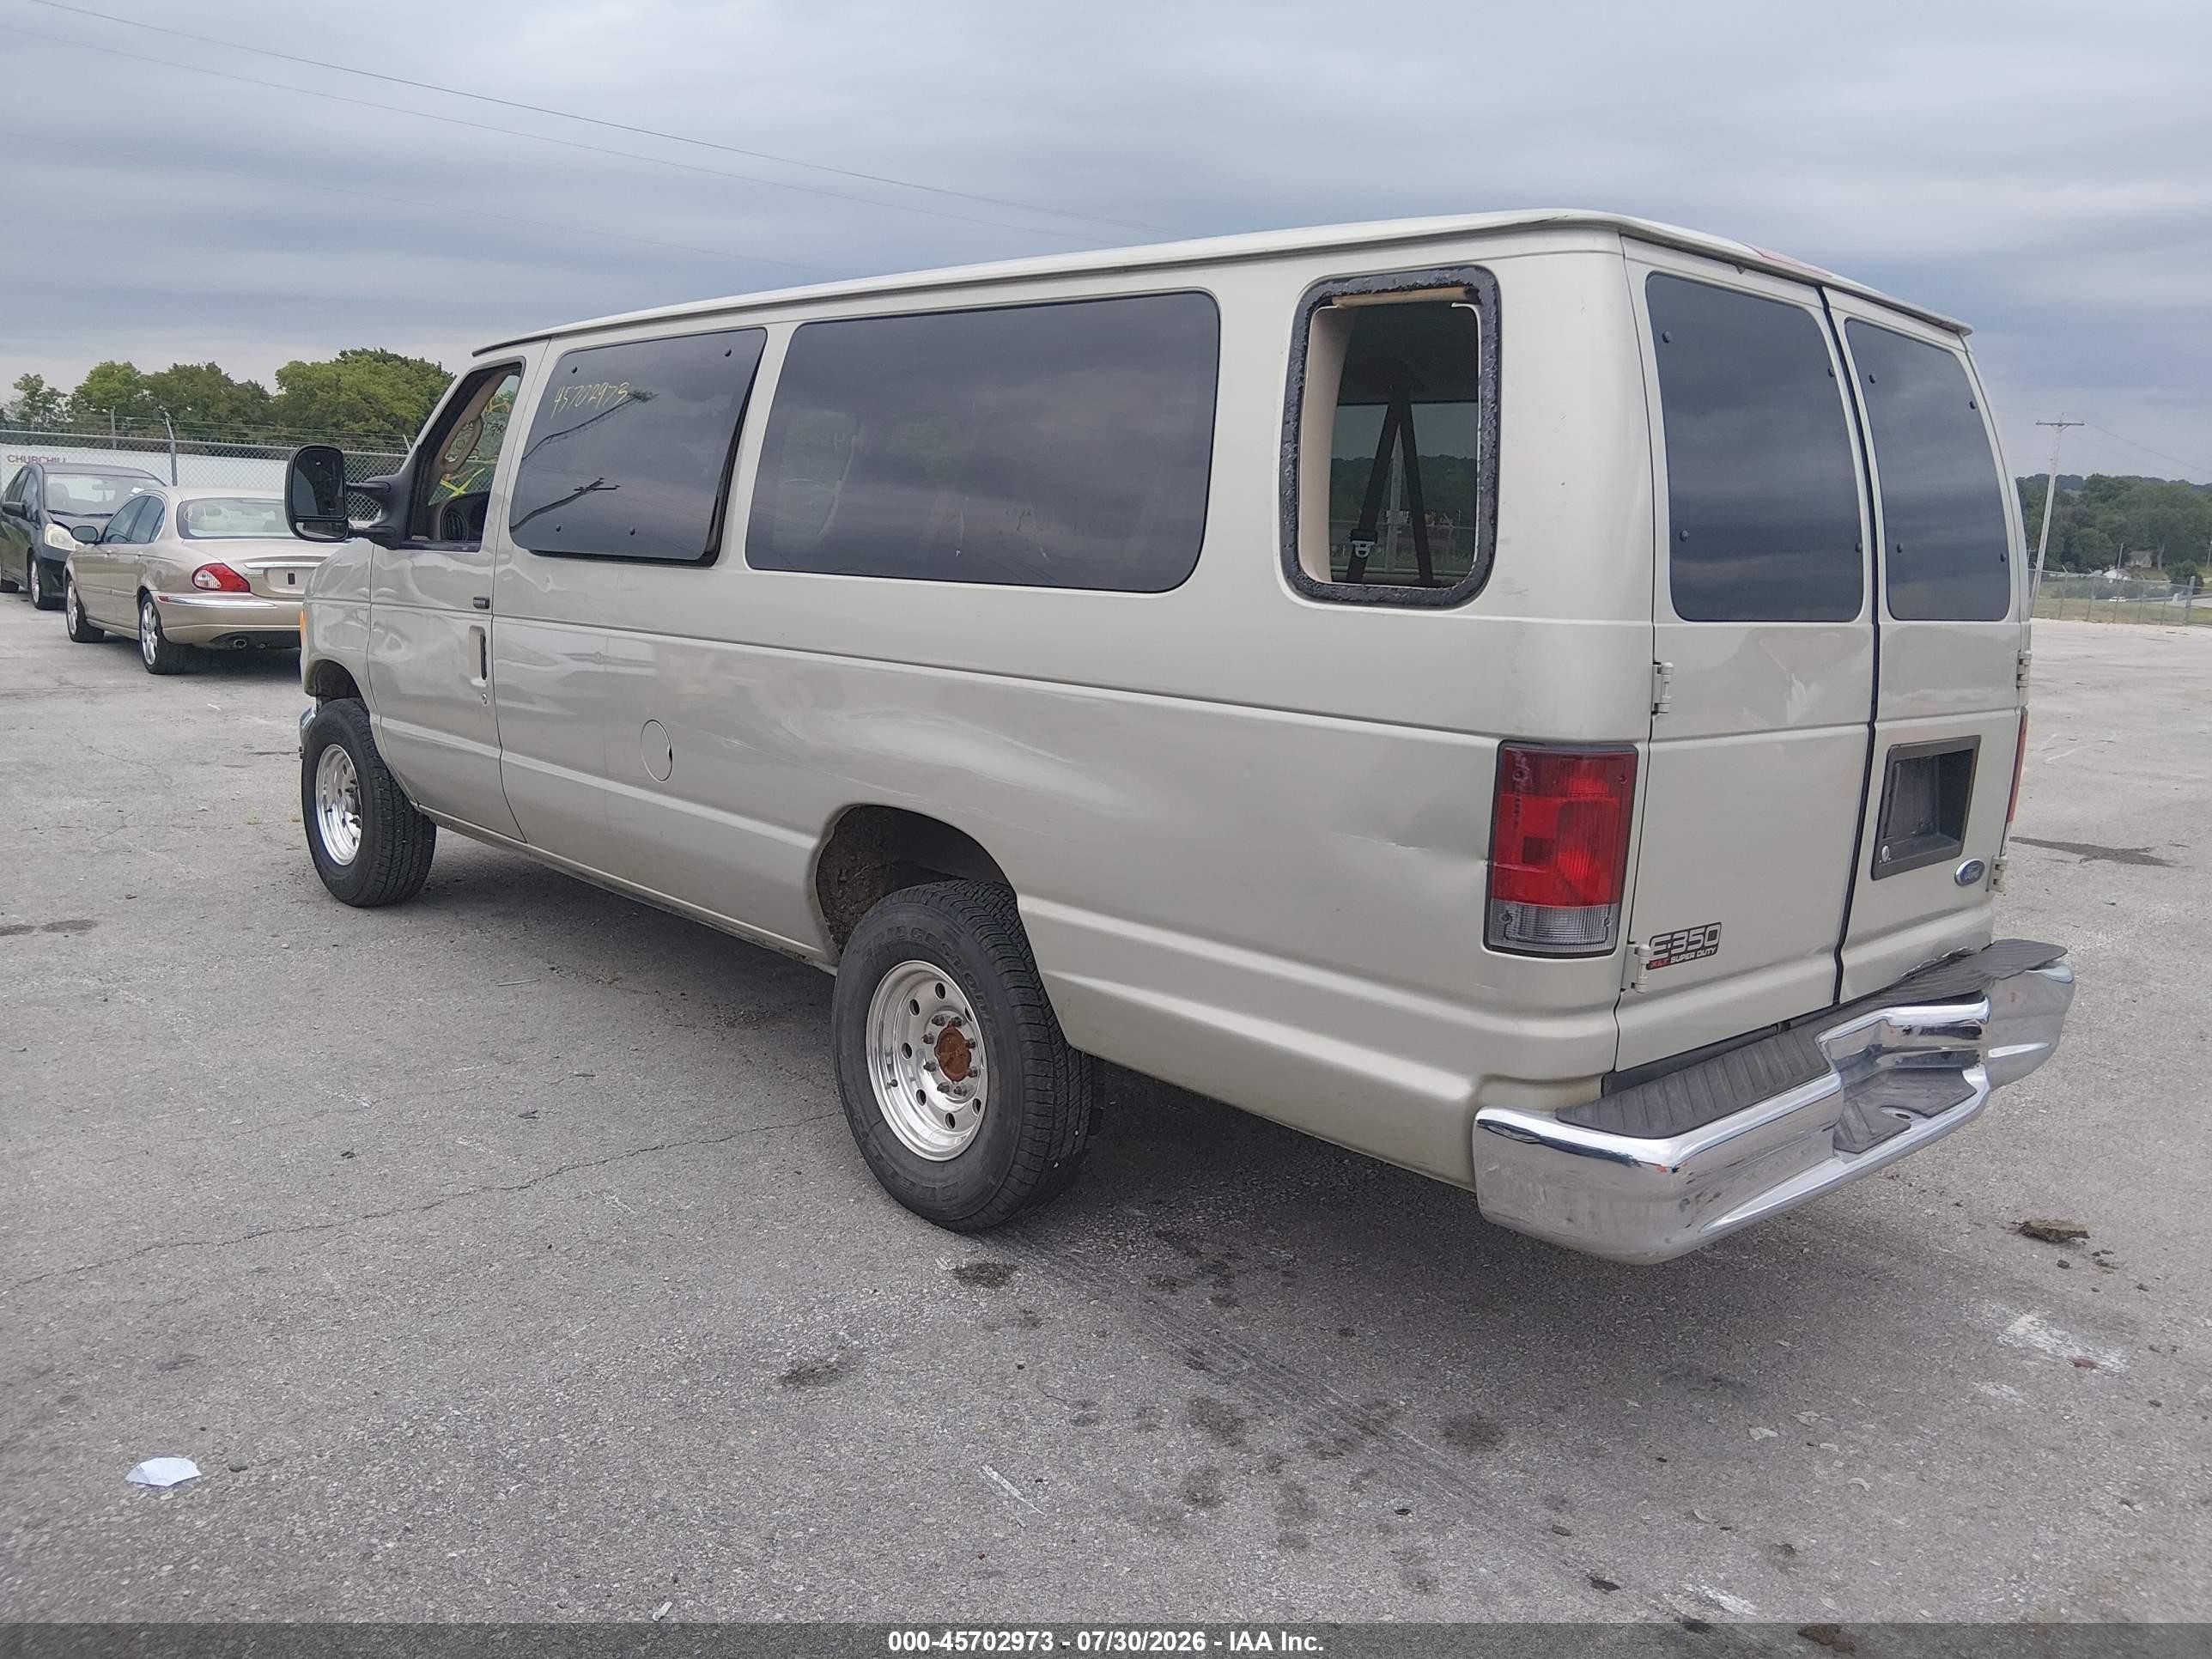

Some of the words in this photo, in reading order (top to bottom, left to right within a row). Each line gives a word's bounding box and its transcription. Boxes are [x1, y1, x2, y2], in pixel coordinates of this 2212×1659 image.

[550, 382, 629, 419] 45702973
[1670, 951, 1696, 963] SUPER
[1696, 945, 1717, 957] DUTY
